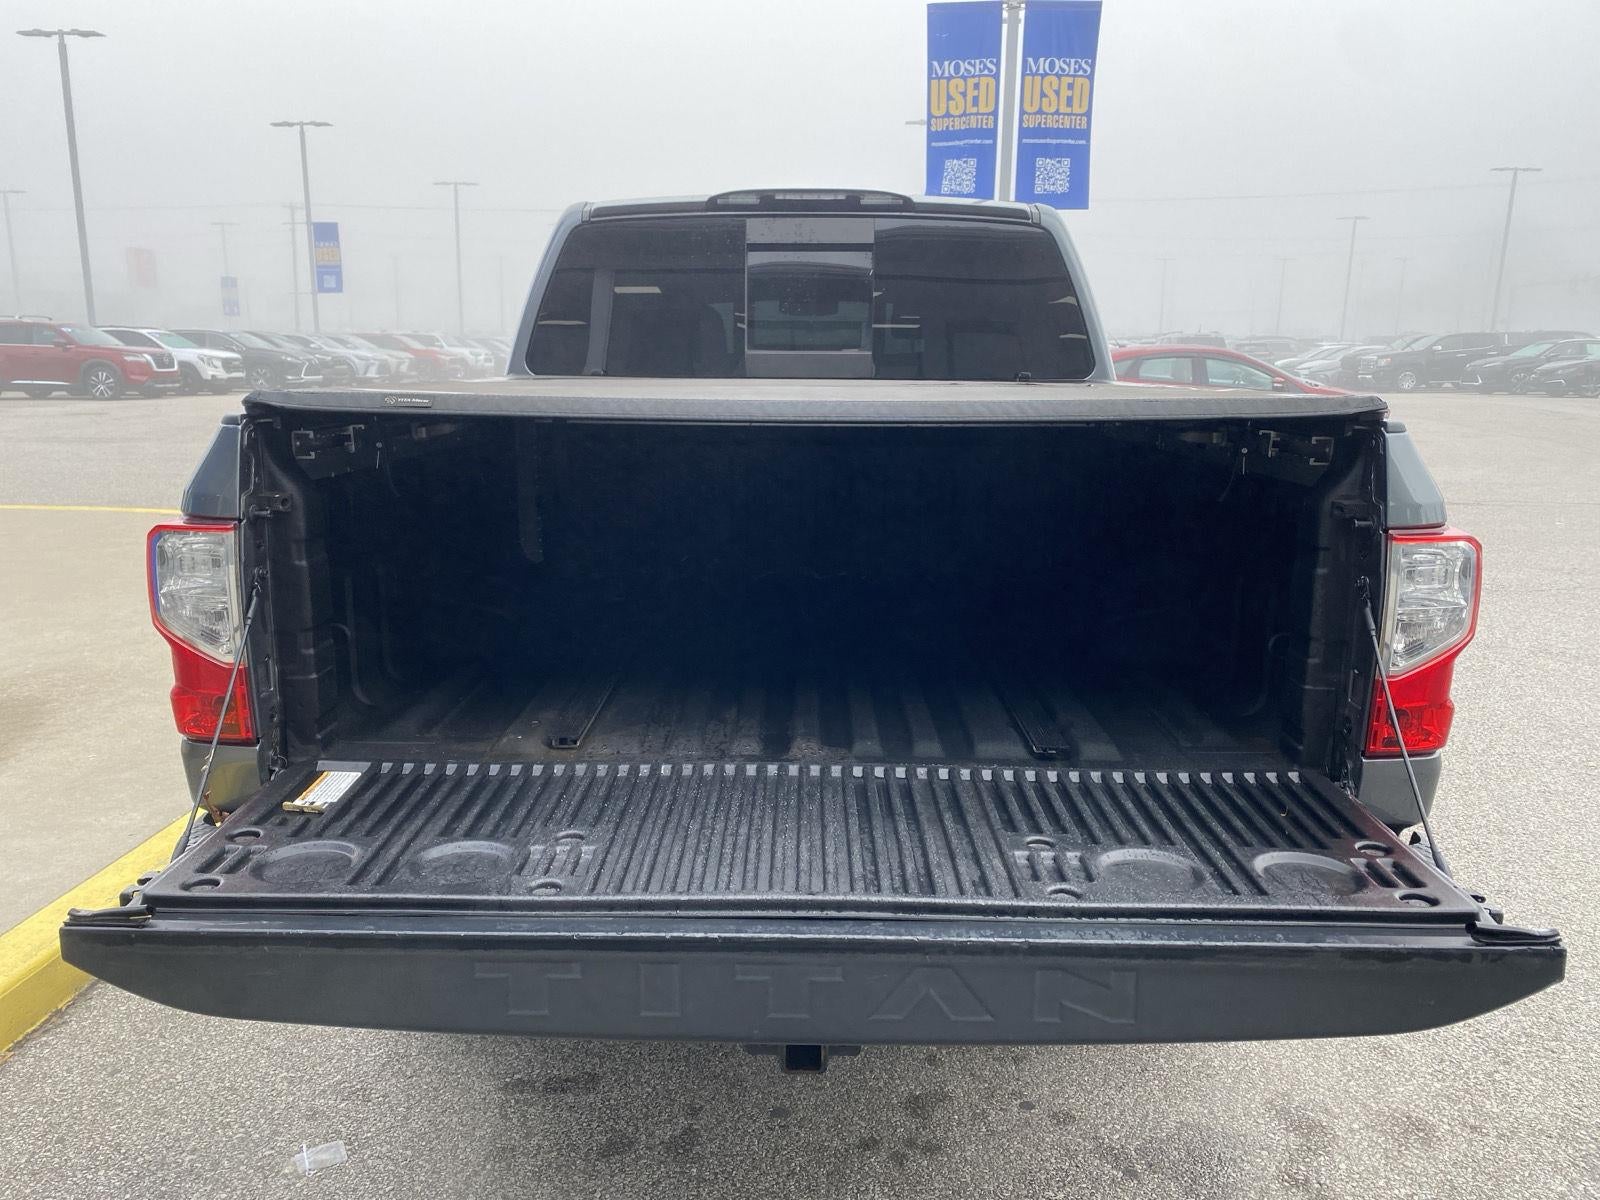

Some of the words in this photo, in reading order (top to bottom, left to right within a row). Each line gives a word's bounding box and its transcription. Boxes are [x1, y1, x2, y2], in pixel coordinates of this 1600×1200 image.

[931, 58, 997, 77] MOSES
[1025, 57, 1091, 75] MOSES
[930, 76, 996, 116] USED
[1023, 75, 1090, 114] USED
[930, 115, 994, 131] SUPERCENTER
[1022, 114, 1088, 129] SUPERCENTER
[473, 961, 1137, 1025] TITAN
